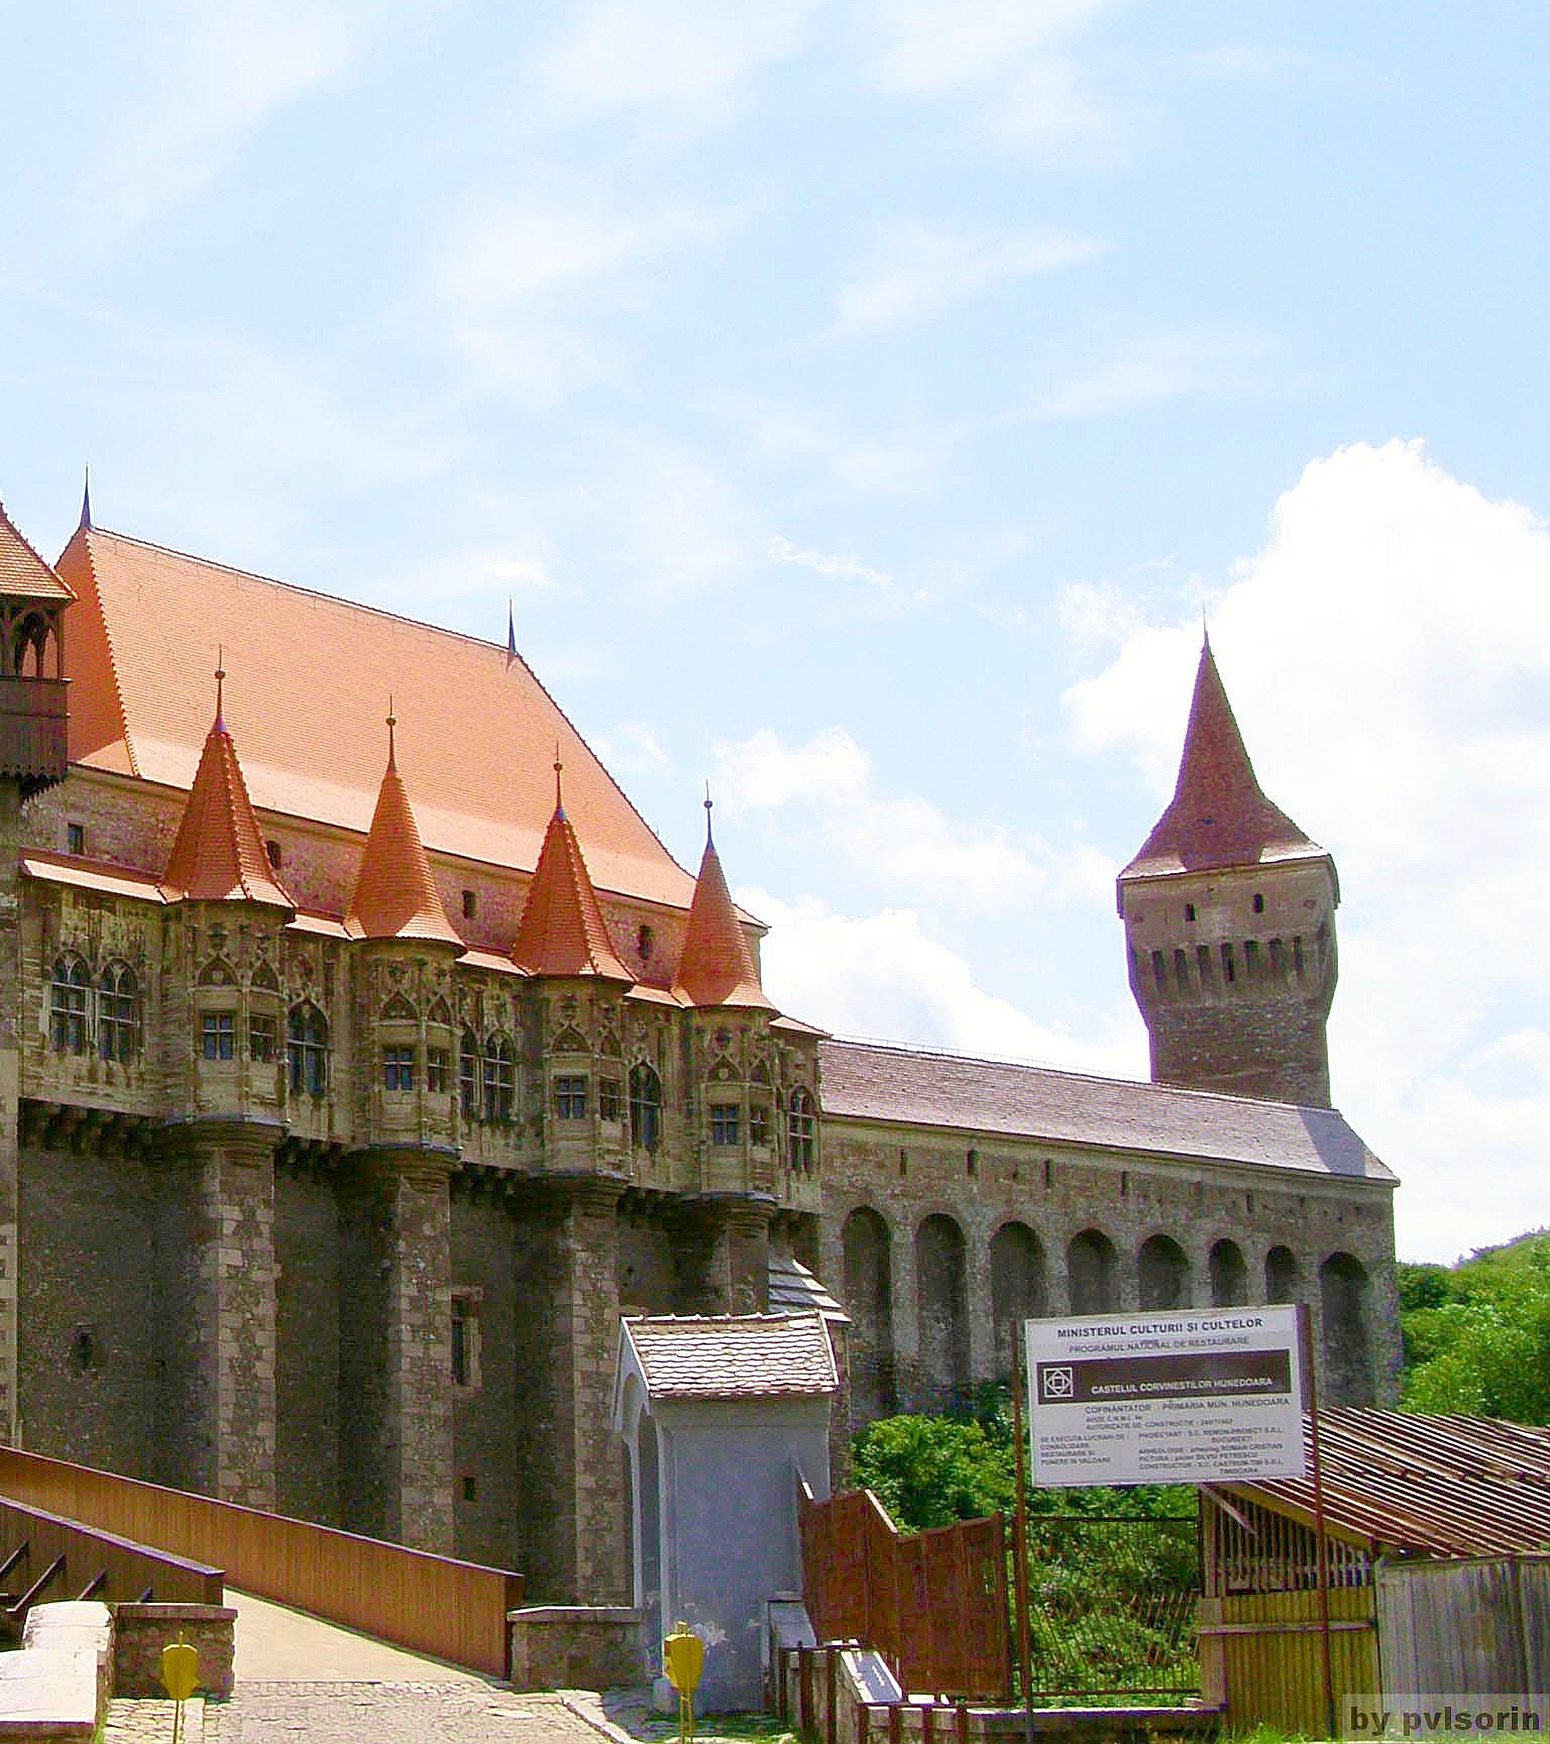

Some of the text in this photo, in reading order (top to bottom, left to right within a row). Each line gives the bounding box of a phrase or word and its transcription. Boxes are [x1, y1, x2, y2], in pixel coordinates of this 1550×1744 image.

[1058, 1326, 1126, 1338] MINISTERUL
[1130, 1323, 1182, 1335] CULTURII
[1202, 1318, 1263, 1331] CULTELOR
[1069, 1343, 1124, 1353] PROGRAMUL
[1188, 1336, 1250, 1347] RESTAURARE
[1091, 1384, 1138, 1395] CASTELUL
[1214, 1376, 1273, 1388] HUNEDOARA
[1233, 1397, 1290, 1408] HUNEDOARA
